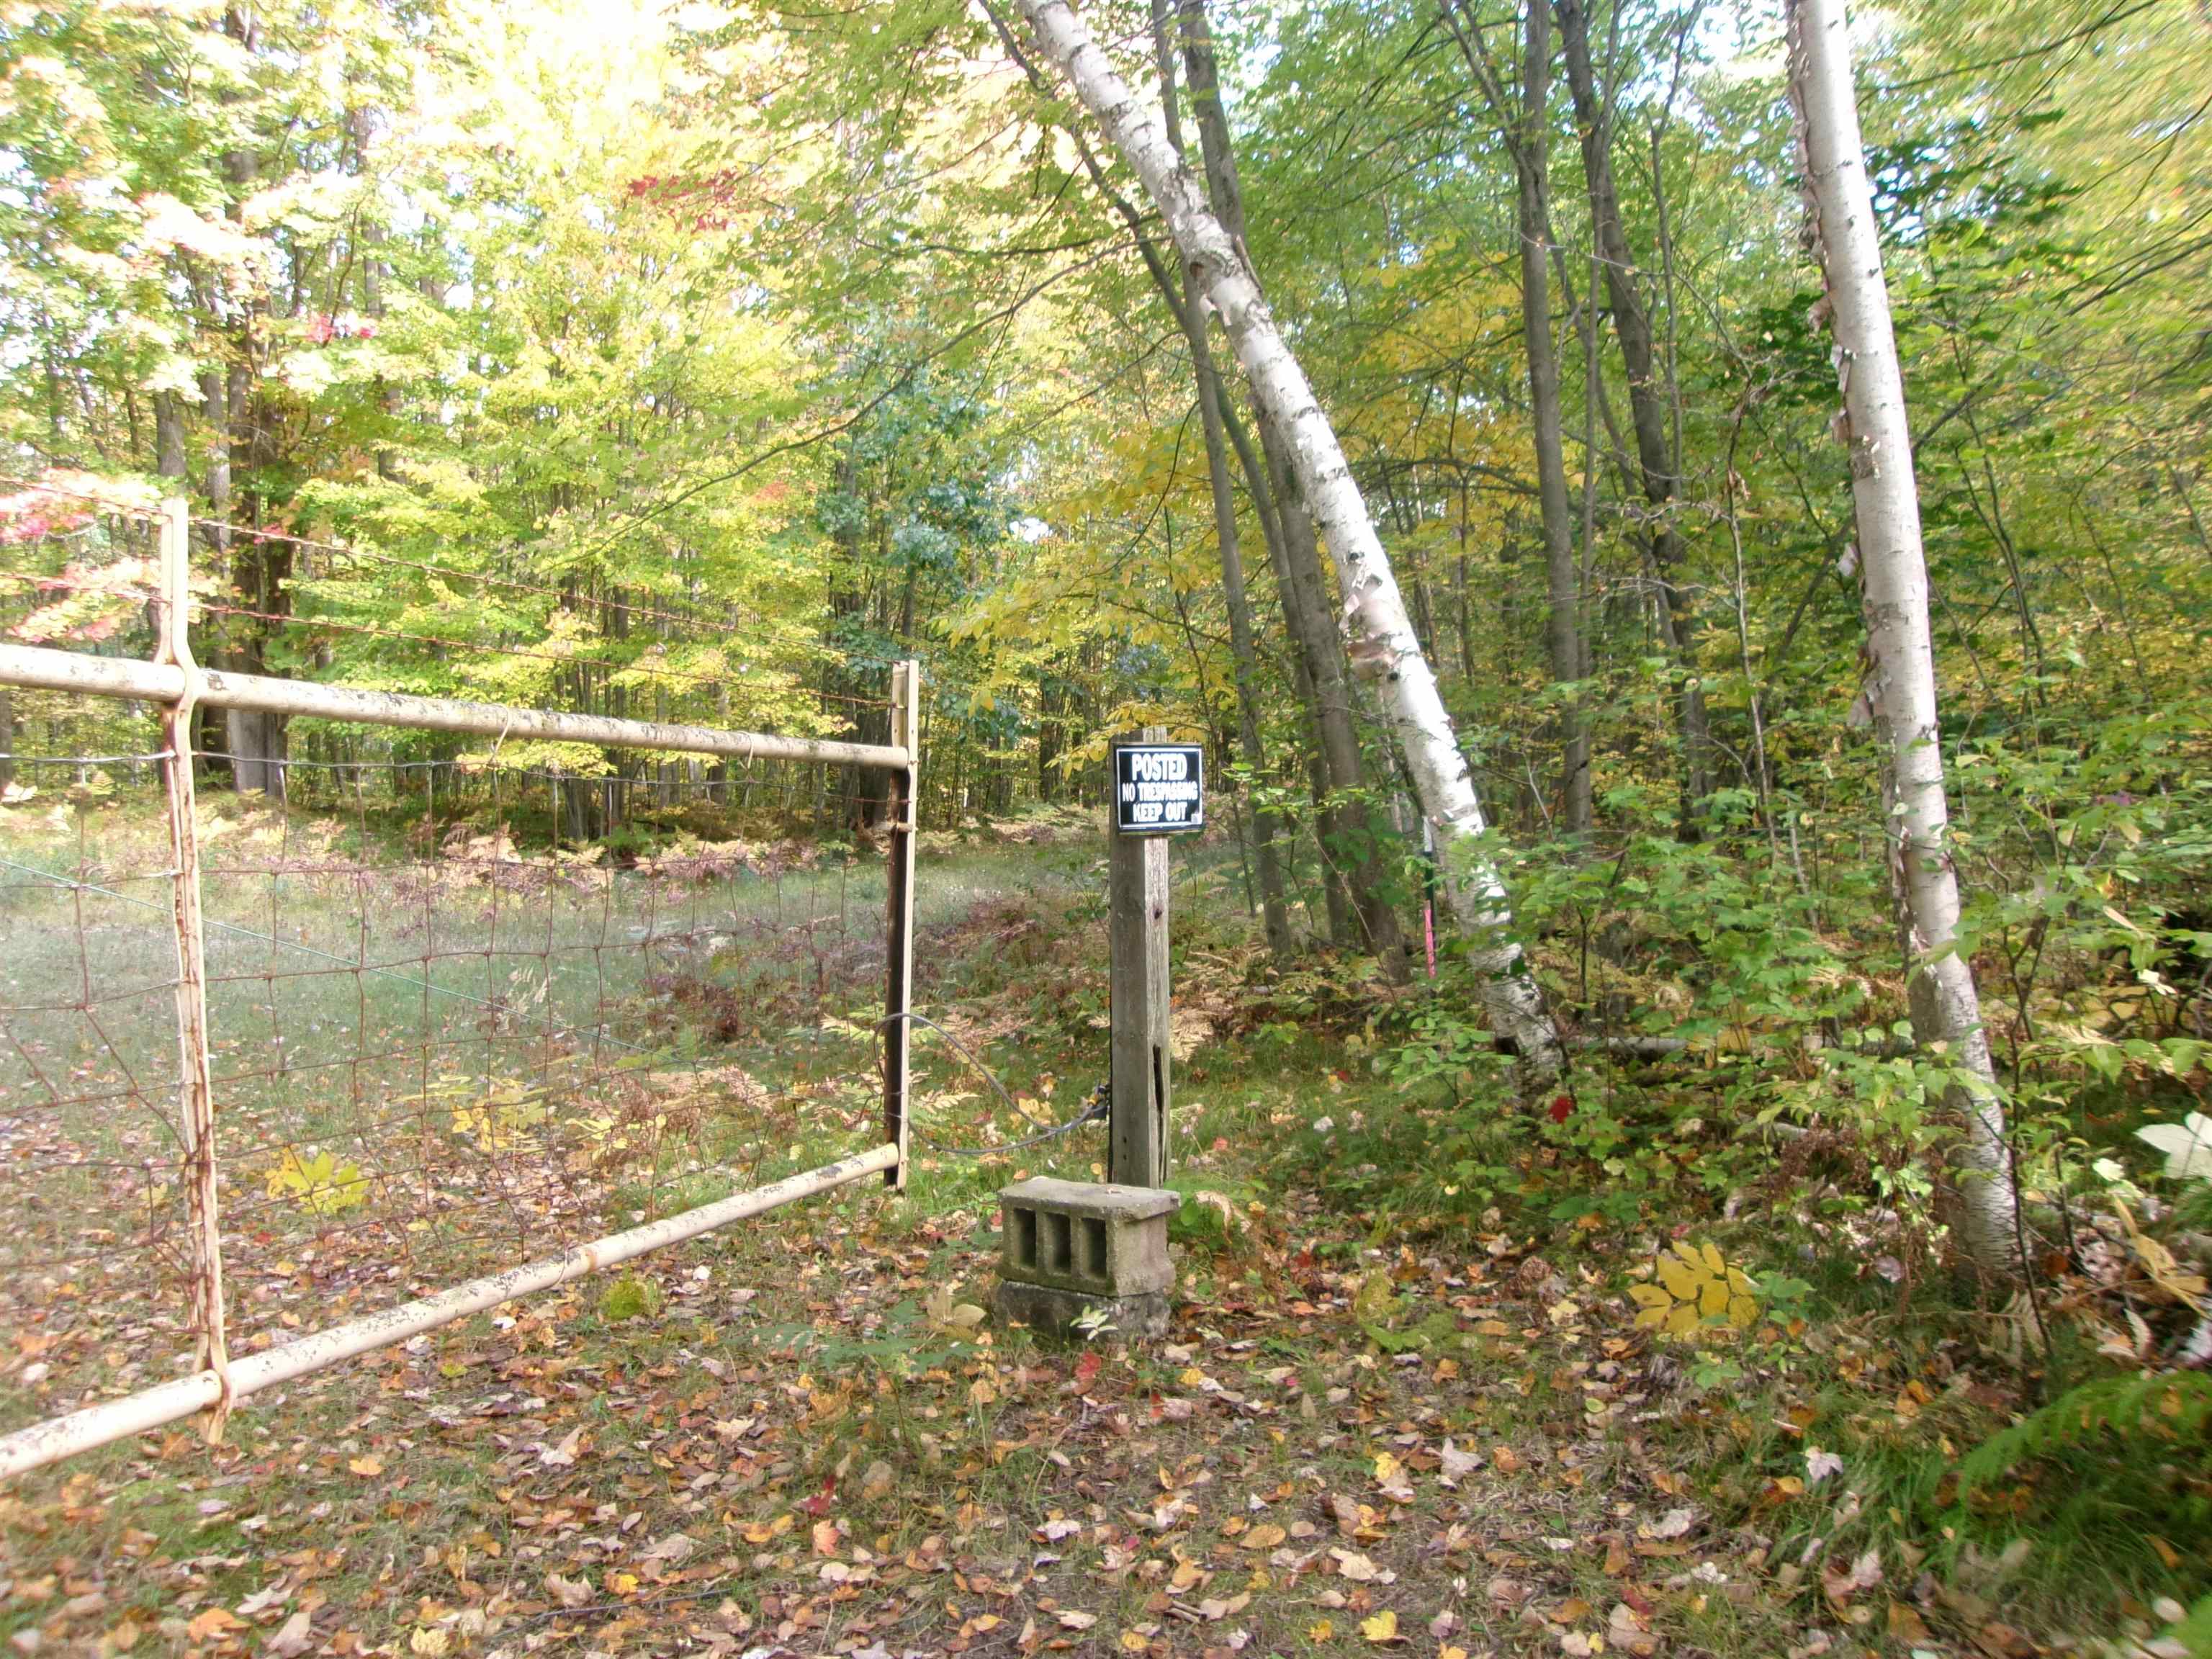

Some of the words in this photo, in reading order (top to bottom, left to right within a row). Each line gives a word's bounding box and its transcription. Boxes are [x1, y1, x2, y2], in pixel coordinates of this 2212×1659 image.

[1132, 753, 1187, 781] POSTED
[1122, 783, 1136, 801] NO
[1133, 803, 1163, 822] KEEP
[1165, 801, 1187, 821] OUT
